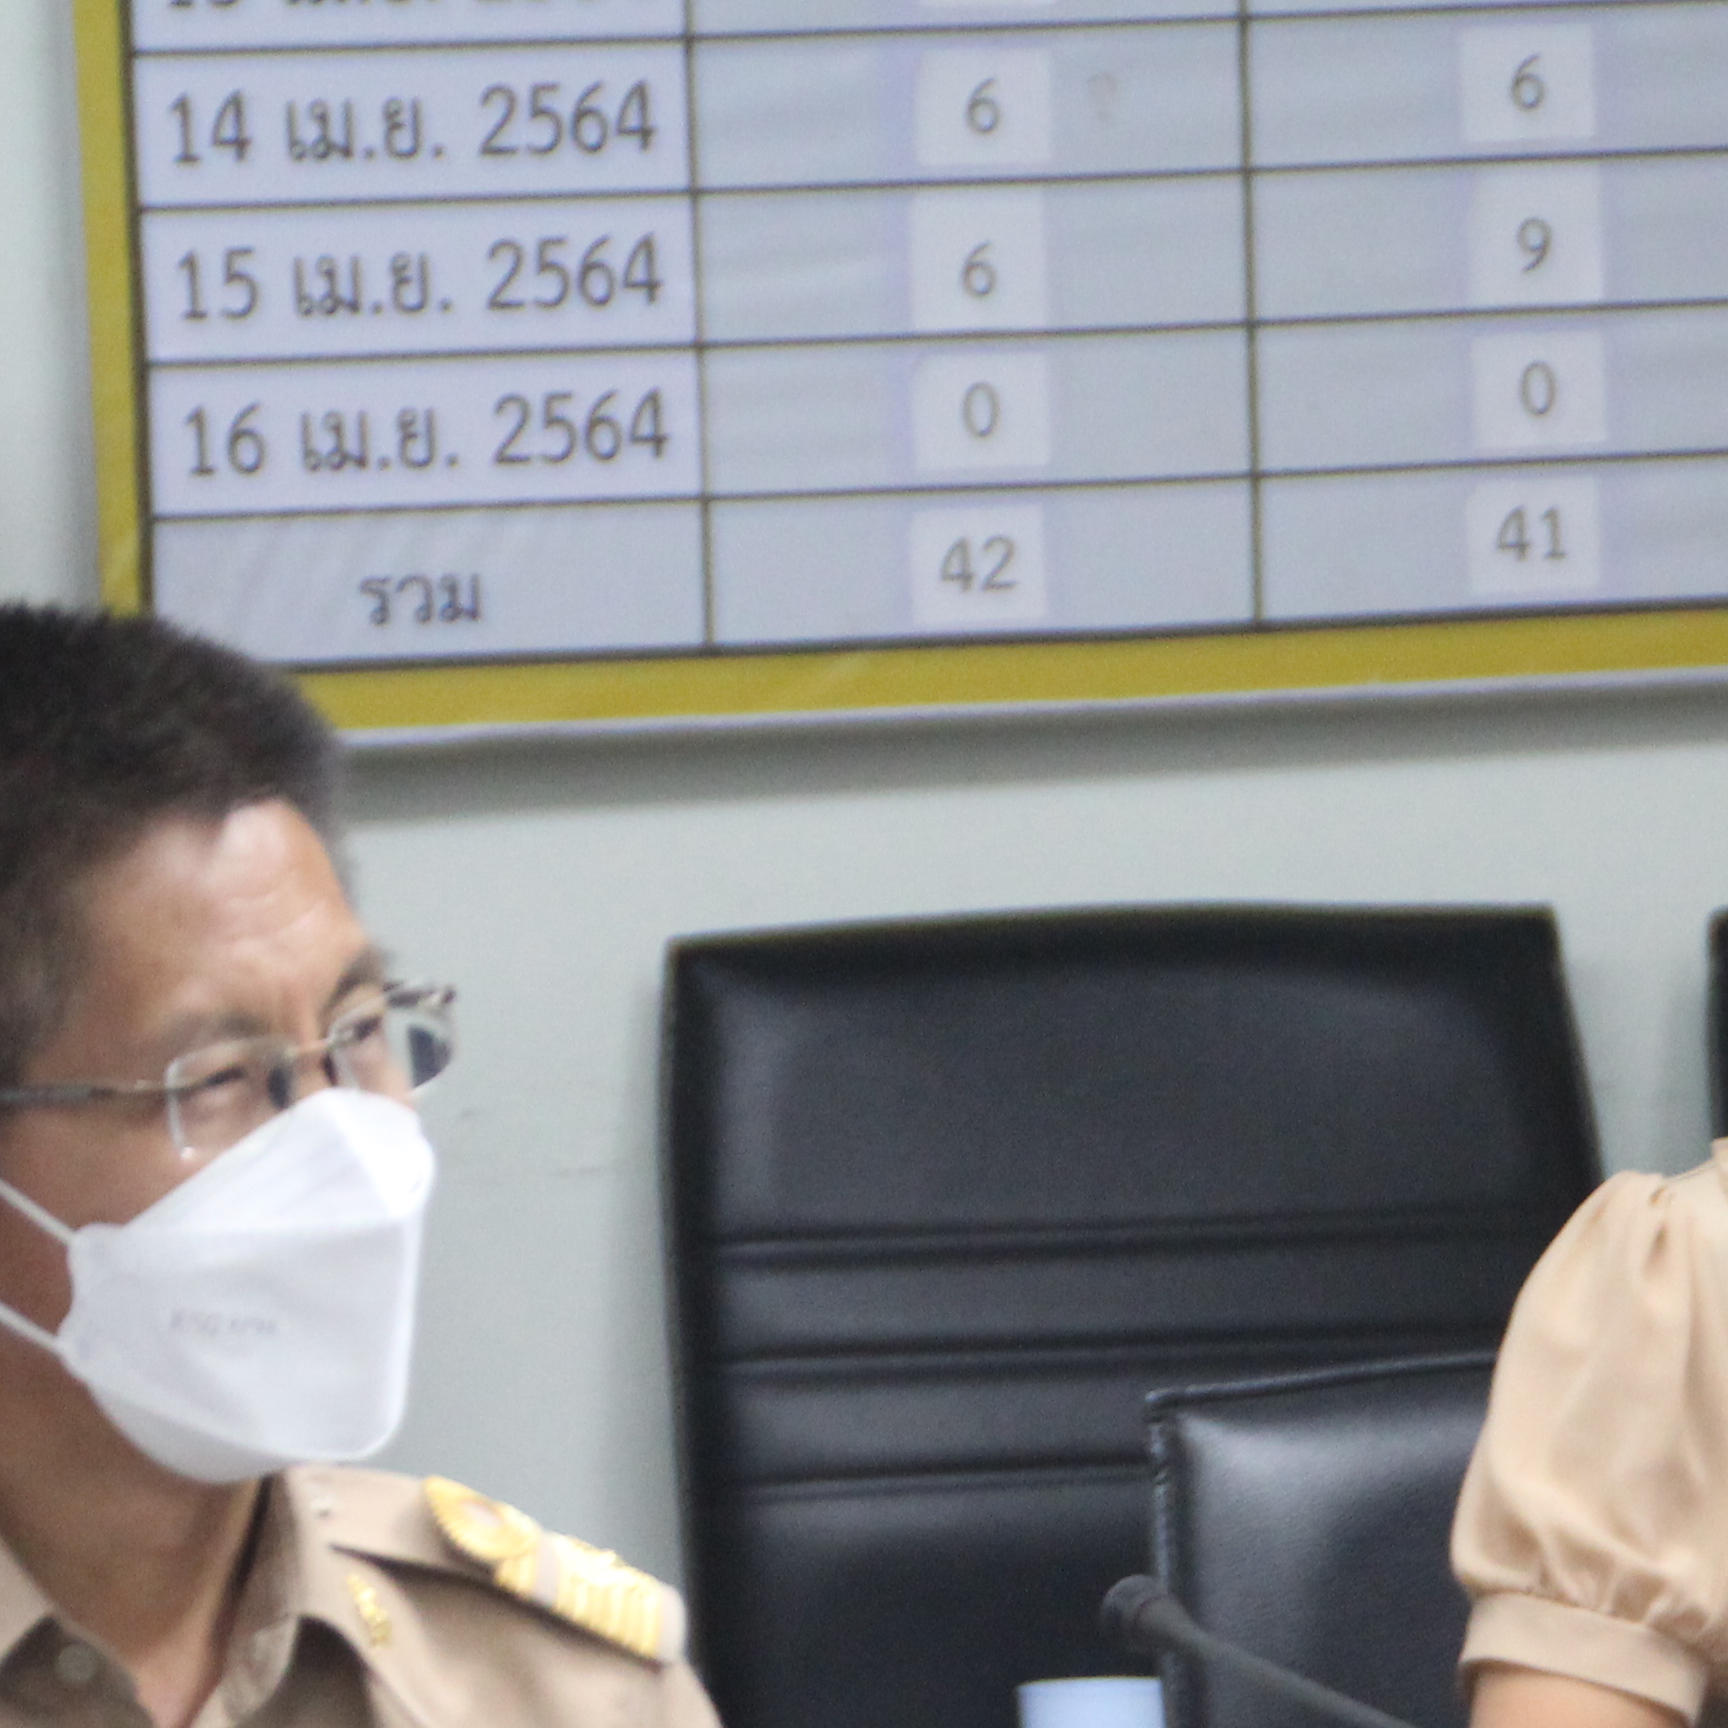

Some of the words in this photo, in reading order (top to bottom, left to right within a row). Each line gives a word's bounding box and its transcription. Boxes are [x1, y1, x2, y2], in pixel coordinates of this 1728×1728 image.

[965, 78, 1002, 137] 6
[1510, 55, 1546, 114] 6
[172, 92, 253, 169] 14
[286, 99, 445, 164] เม.ย.
[480, 81, 657, 160] 2564
[961, 242, 998, 301] 6
[1517, 218, 1553, 274] 9
[179, 246, 261, 325] 15
[294, 255, 453, 321] เม.ย.
[487, 235, 663, 313] 2564
[961, 381, 1002, 443] 0
[1518, 360, 1559, 420] 0
[187, 404, 267, 479] 16
[301, 410, 459, 475] เม.ย.
[494, 389, 670, 468] 2564
[1496, 507, 1567, 562] 41
[940, 535, 1017, 594] 42
[360, 575, 483, 628] รวม
